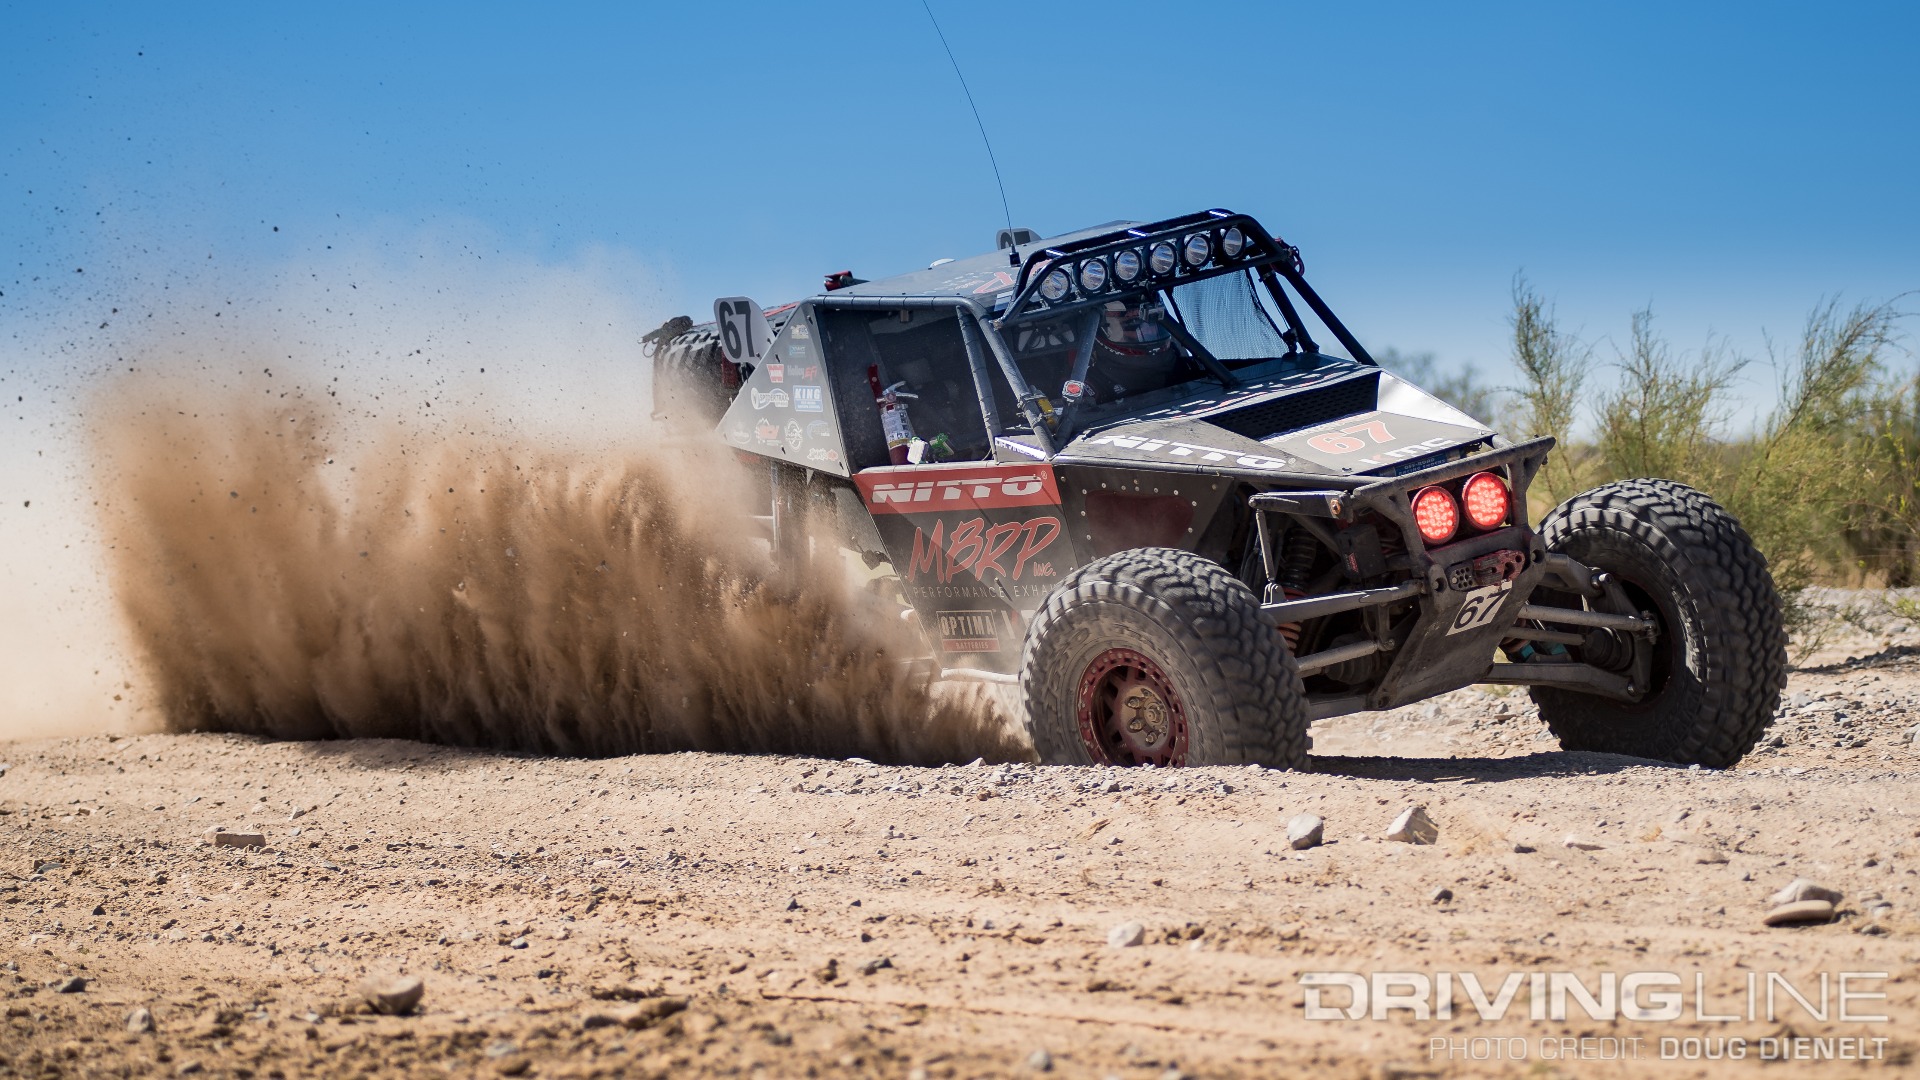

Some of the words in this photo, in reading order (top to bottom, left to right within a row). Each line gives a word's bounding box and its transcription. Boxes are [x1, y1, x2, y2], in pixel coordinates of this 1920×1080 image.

[719, 301, 755, 359] 67
[795, 388, 820, 400] KING
[1306, 420, 1396, 455] 67
[1091, 435, 1287, 469] NITTO
[872, 475, 1043, 503] NITTO
[908, 516, 1061, 584] MBRP
[1033, 562, 1057, 577] INC.
[913, 586, 1005, 598] PERFORMANCE
[1453, 589, 1511, 629] 67
[940, 615, 995, 636] OPTIMA
[955, 641, 989, 650] BATTERIES
